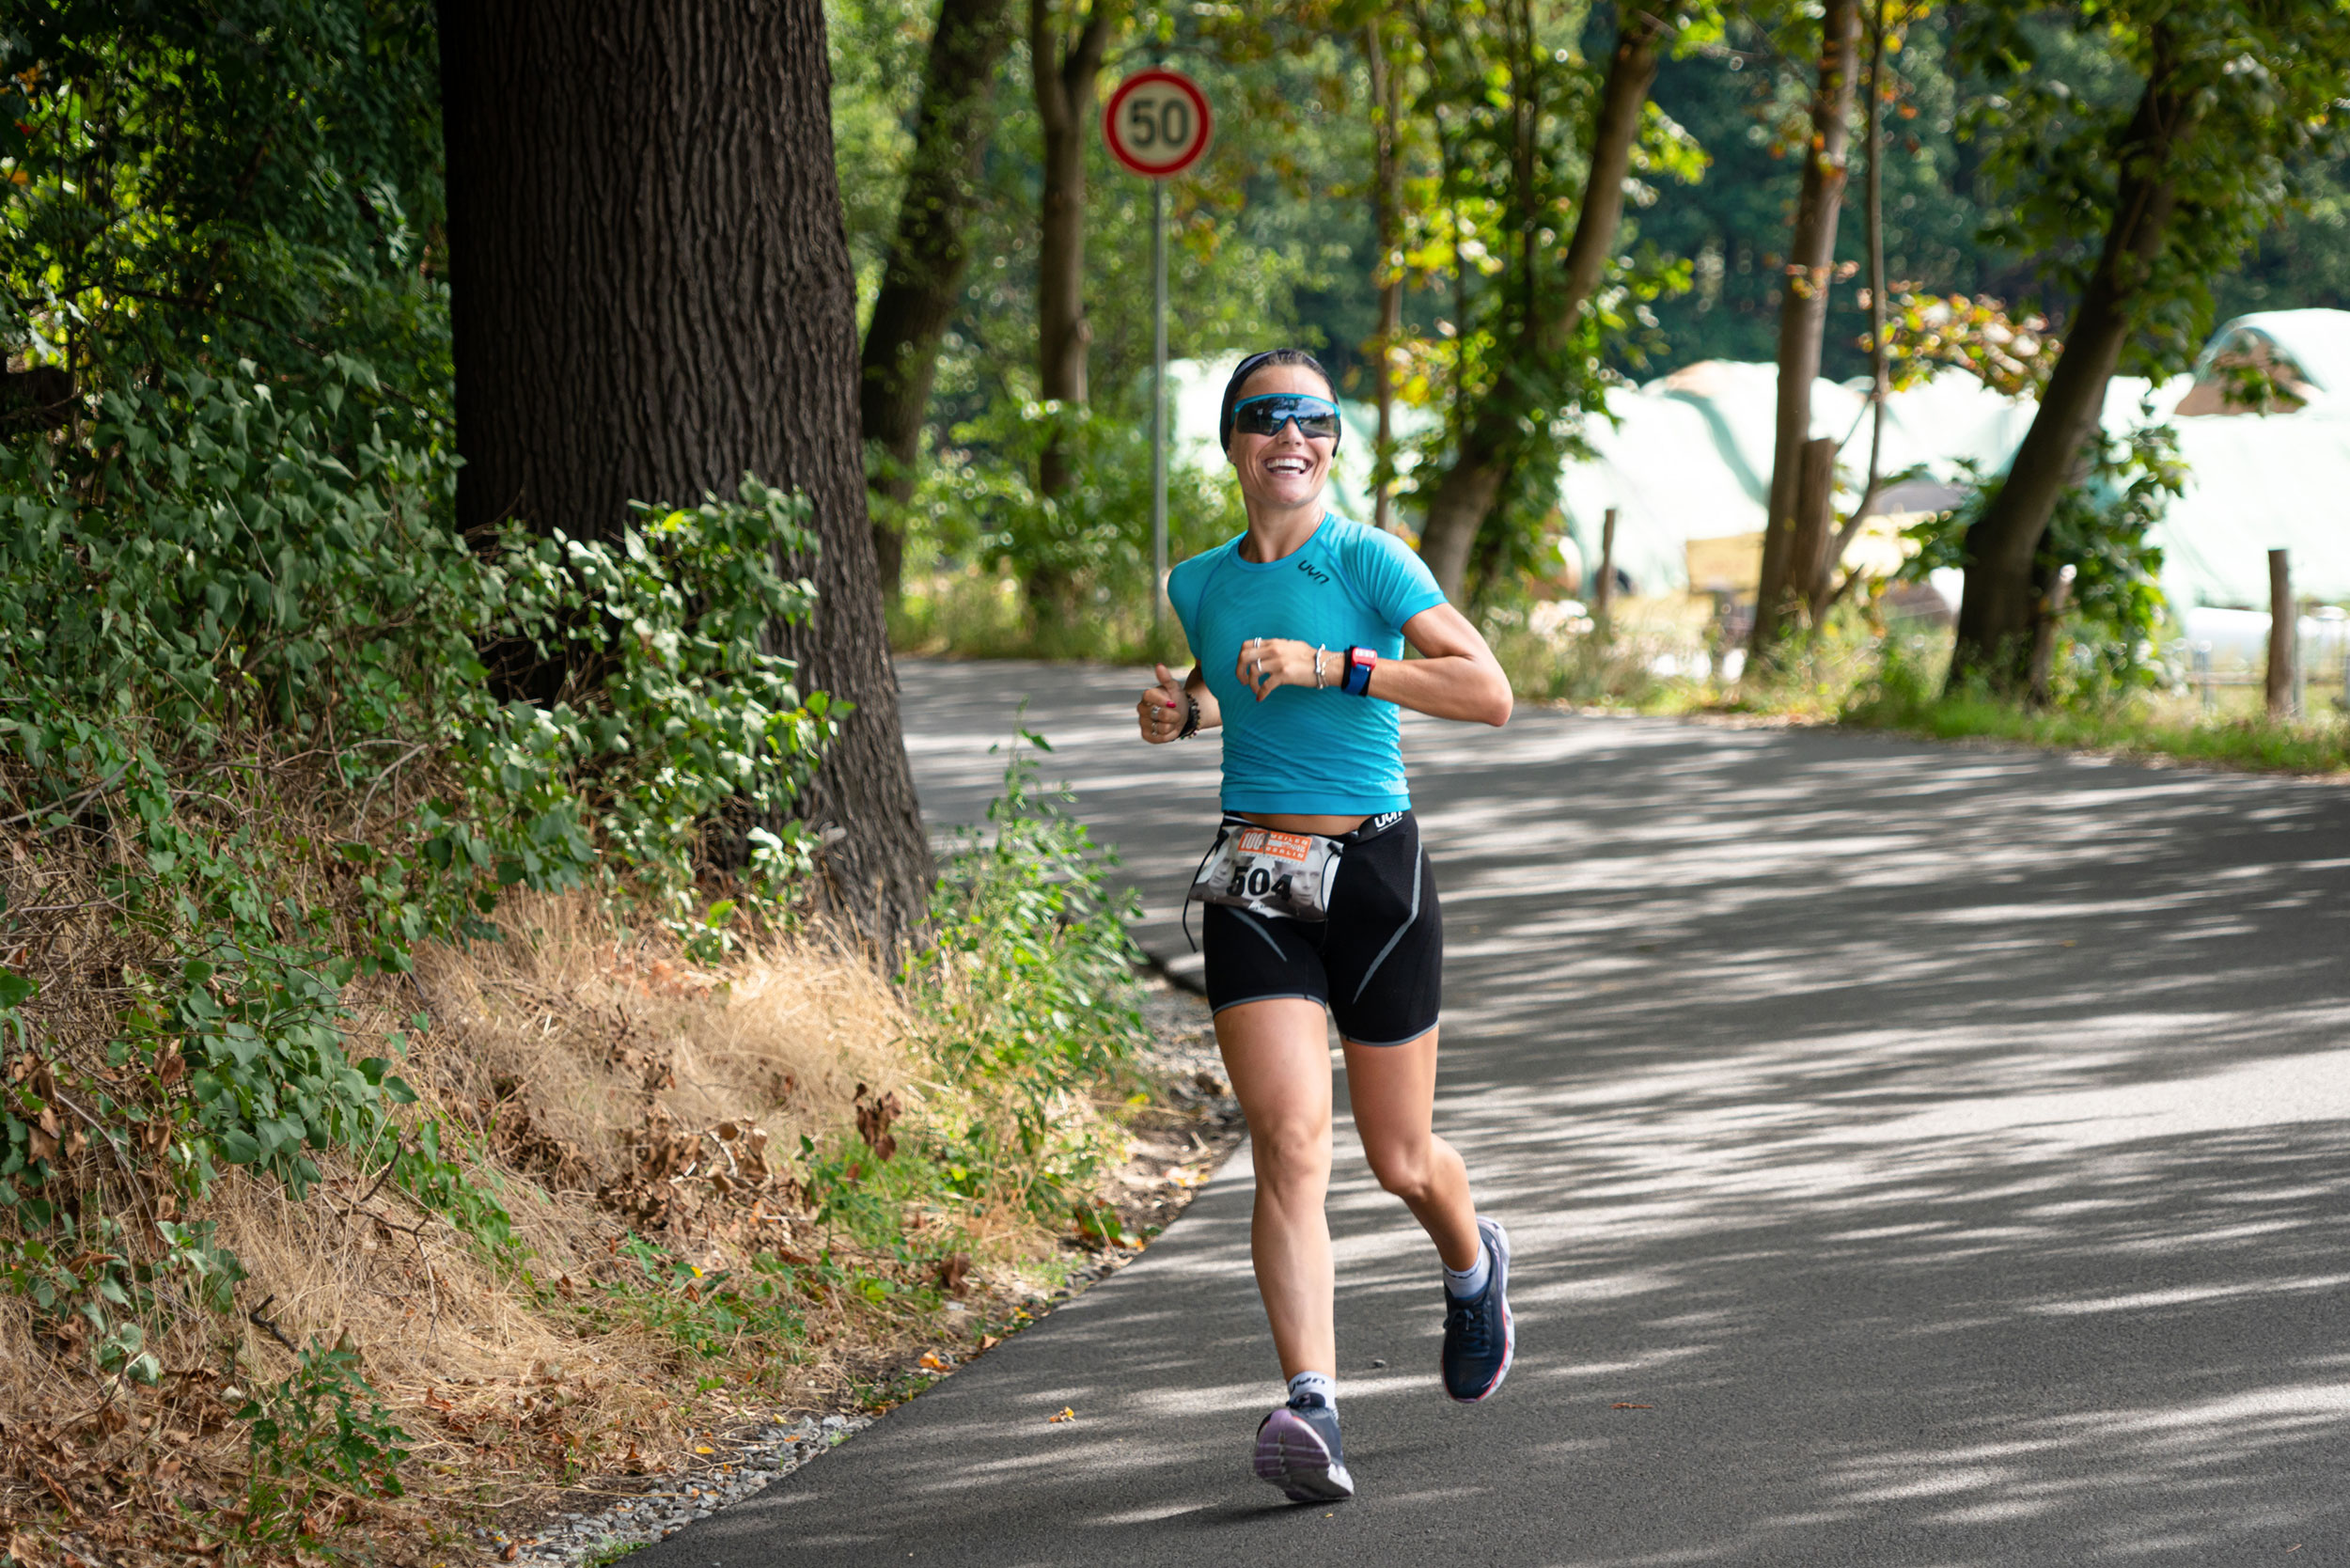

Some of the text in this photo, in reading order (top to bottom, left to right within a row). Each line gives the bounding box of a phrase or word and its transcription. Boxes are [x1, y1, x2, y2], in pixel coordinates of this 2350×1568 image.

[1130, 98, 1189, 149] 50
[1241, 832, 1265, 850] 100
[1270, 833, 1308, 846] MEILEN
[1265, 846, 1305, 858] BERLIN
[1226, 866, 1293, 901] 504
